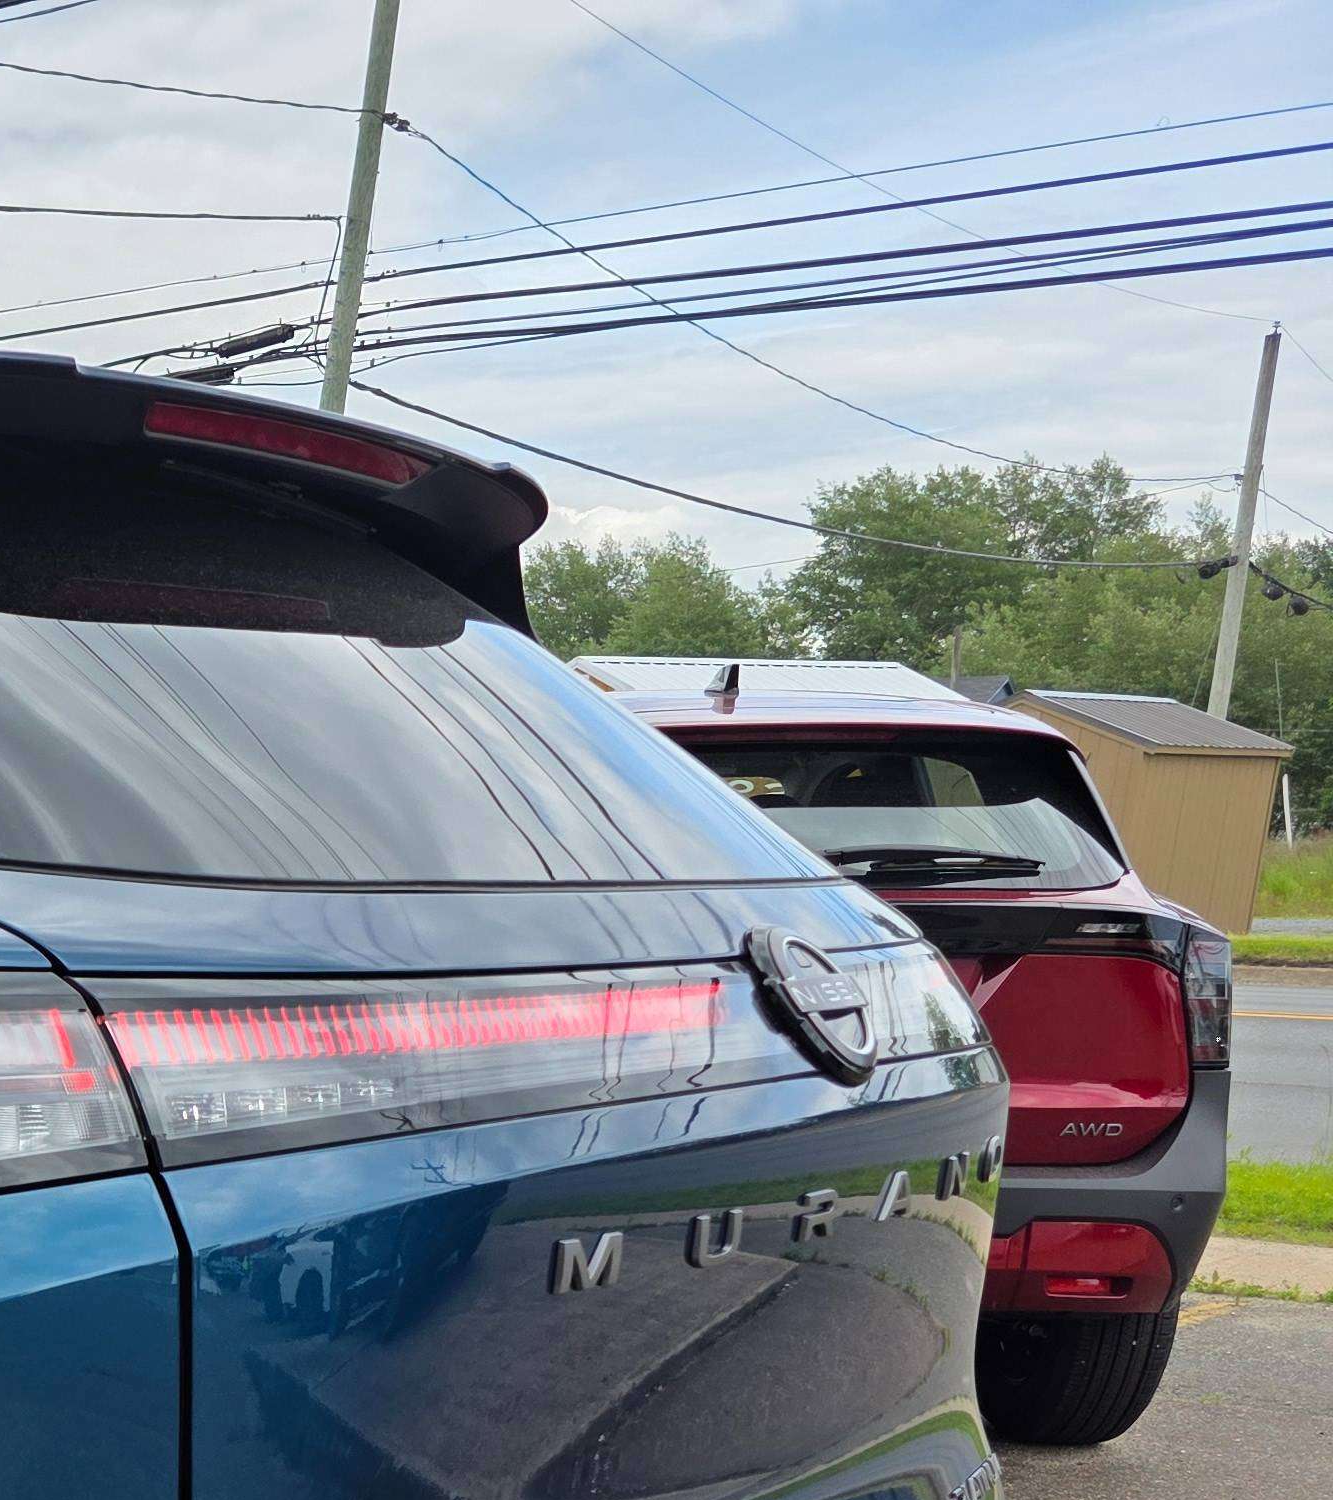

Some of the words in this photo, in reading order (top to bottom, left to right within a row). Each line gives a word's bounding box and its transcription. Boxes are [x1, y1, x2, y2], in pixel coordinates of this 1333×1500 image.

[790, 981, 862, 1006] NISS
[1059, 1122, 1123, 1137] AWD
[547, 1135, 1002, 1295] MURANO
